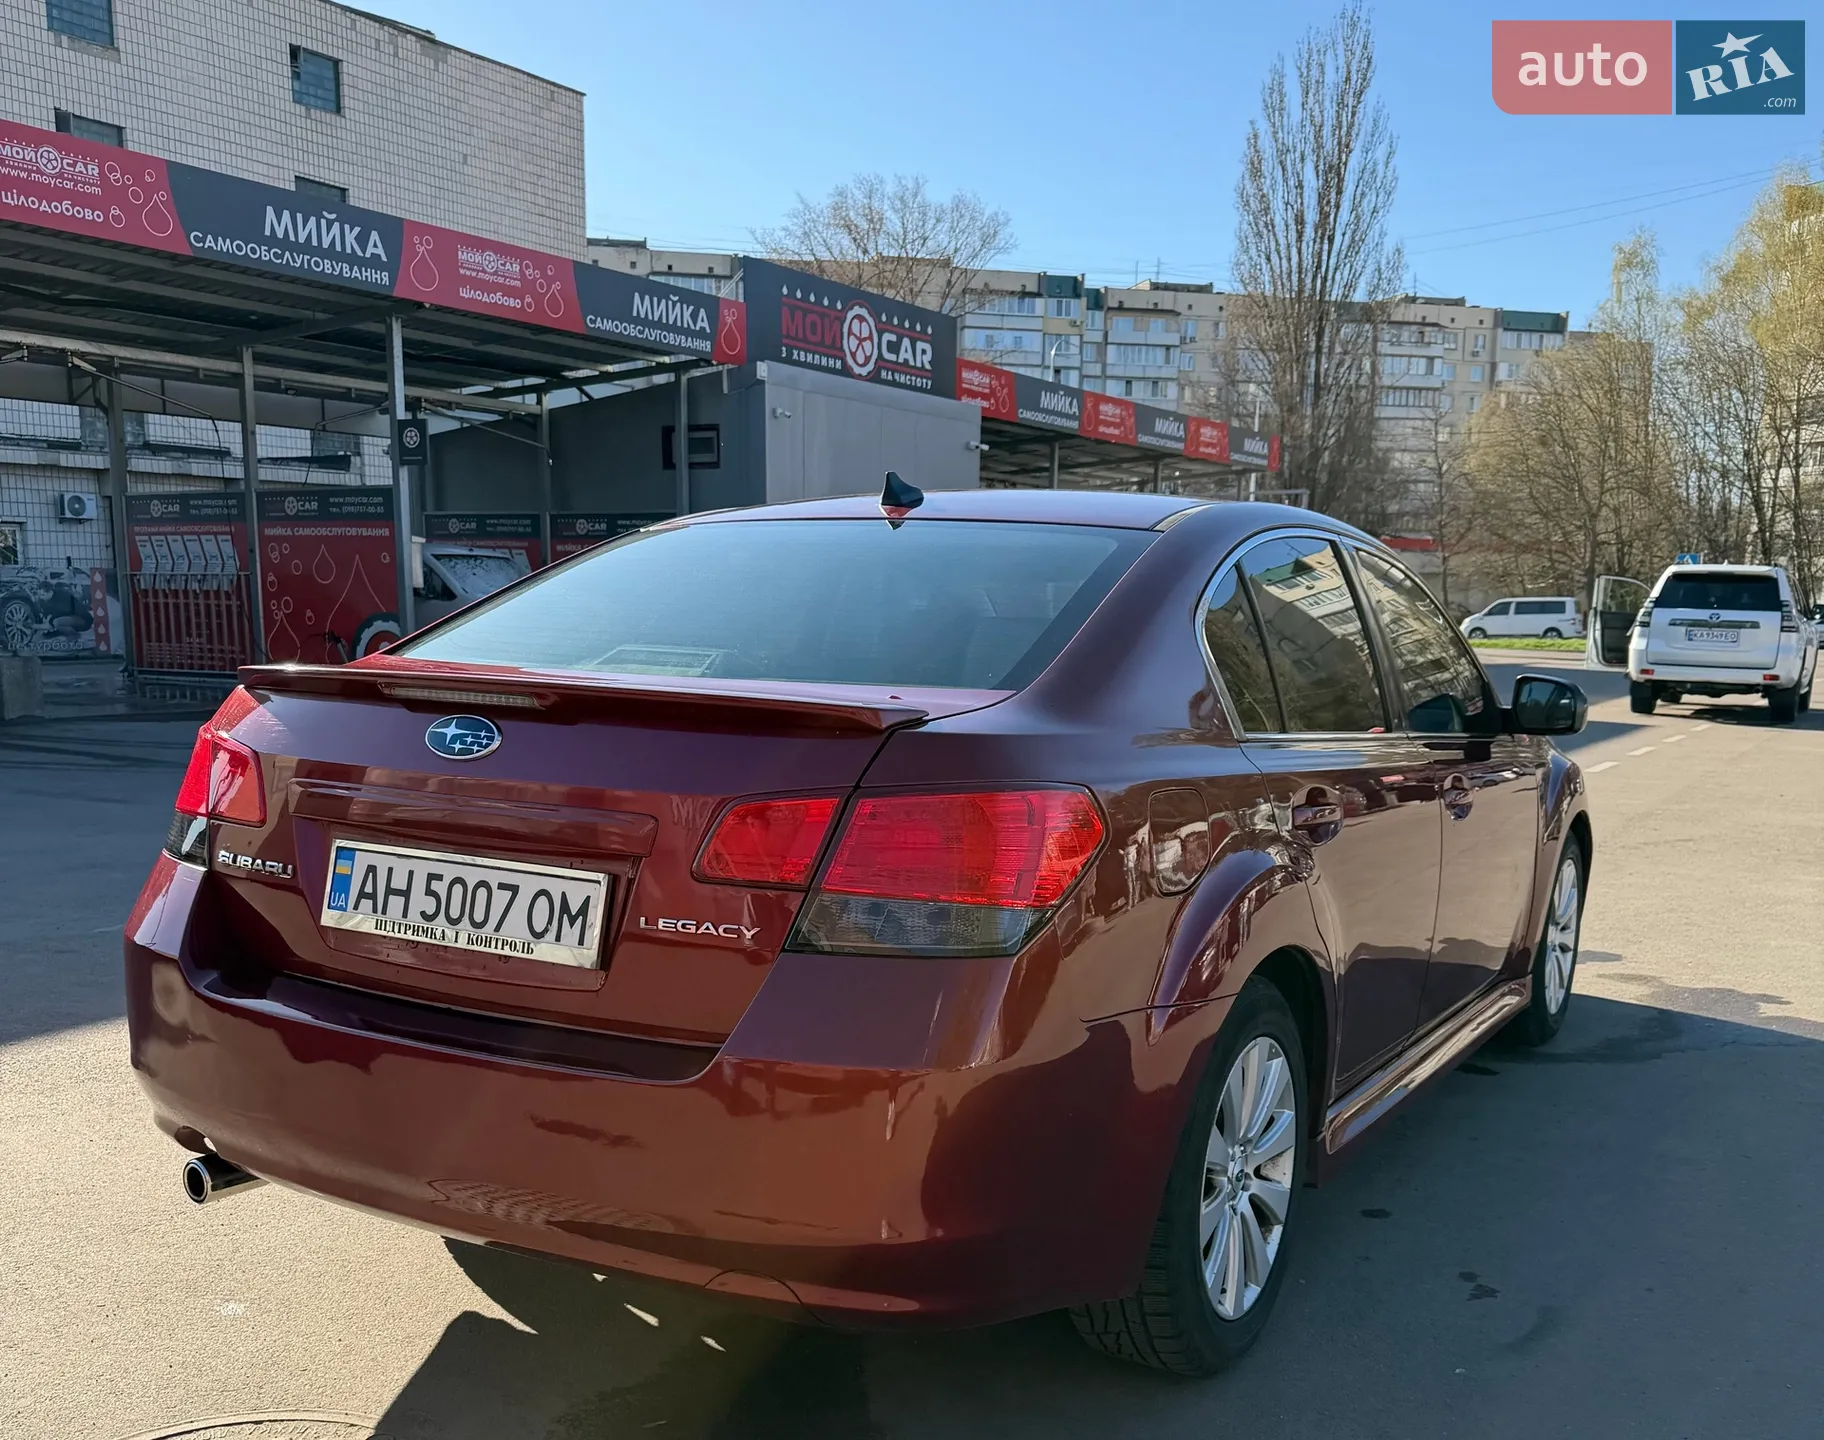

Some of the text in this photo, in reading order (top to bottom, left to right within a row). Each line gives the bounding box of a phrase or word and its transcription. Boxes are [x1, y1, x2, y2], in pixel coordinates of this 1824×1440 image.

[62, 158, 100, 177] CAR
[264, 205, 388, 262] МИЙКА
[189, 231, 390, 286] САМООБСЛУГОВУВАННЯ
[498, 260, 520, 273] CAR
[632, 292, 711, 333] МИЙКА
[586, 315, 712, 353] САМООБСЛУГОВУВАННЯ
[781, 306, 932, 371] МОЙ CAR
[792, 349, 842, 370] ХВИЛИНИ
[1040, 390, 1079, 416] МИЙКА
[1154, 416, 1185, 438] МИЙКА
[162, 504, 180, 513] CAR
[298, 501, 318, 510] CAR
[264, 526, 390, 537] МИЙКА САМООБСЛУГОВУВАННЯ
[218, 849, 293, 879] SUBARU
[330, 891, 346, 908] UA
[353, 864, 591, 946] AH 5007 OM
[374, 918, 446, 942] ПІДТРИМКА
[466, 932, 535, 956] КОНТРОЛЬ
[640, 916, 761, 939] LEGACY
